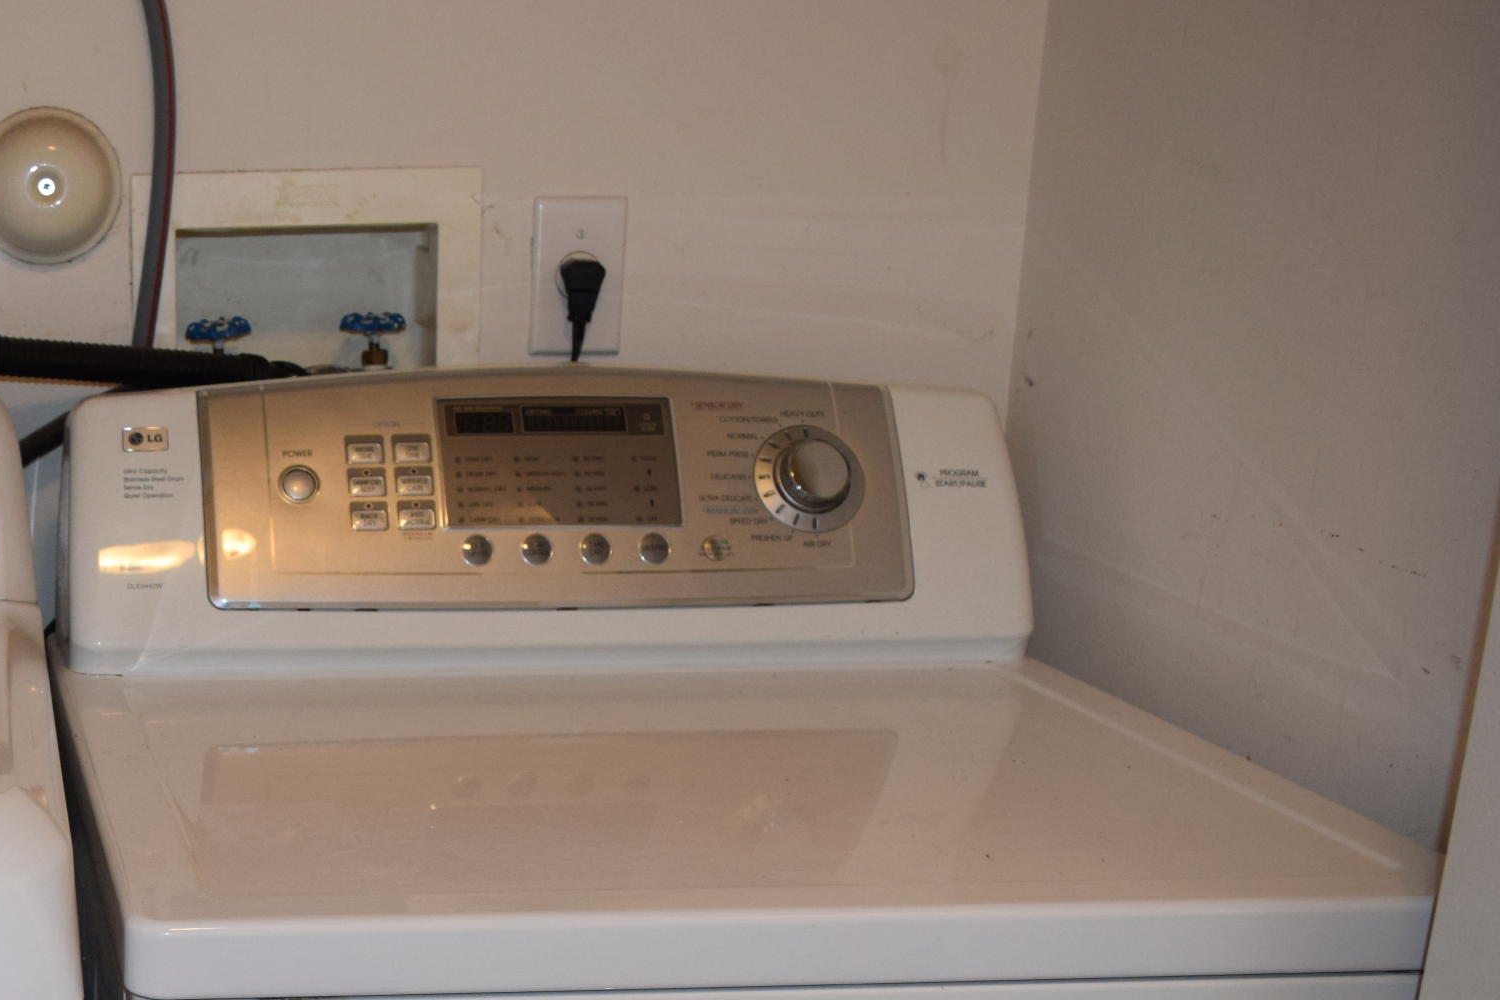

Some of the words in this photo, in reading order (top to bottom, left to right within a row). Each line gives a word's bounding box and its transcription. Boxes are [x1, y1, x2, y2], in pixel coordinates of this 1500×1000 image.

[147, 434, 163, 443] LG
[281, 449, 313, 459] POWER
[939, 468, 980, 477] PROGRAM
[935, 479, 987, 488] START/PAUSE
